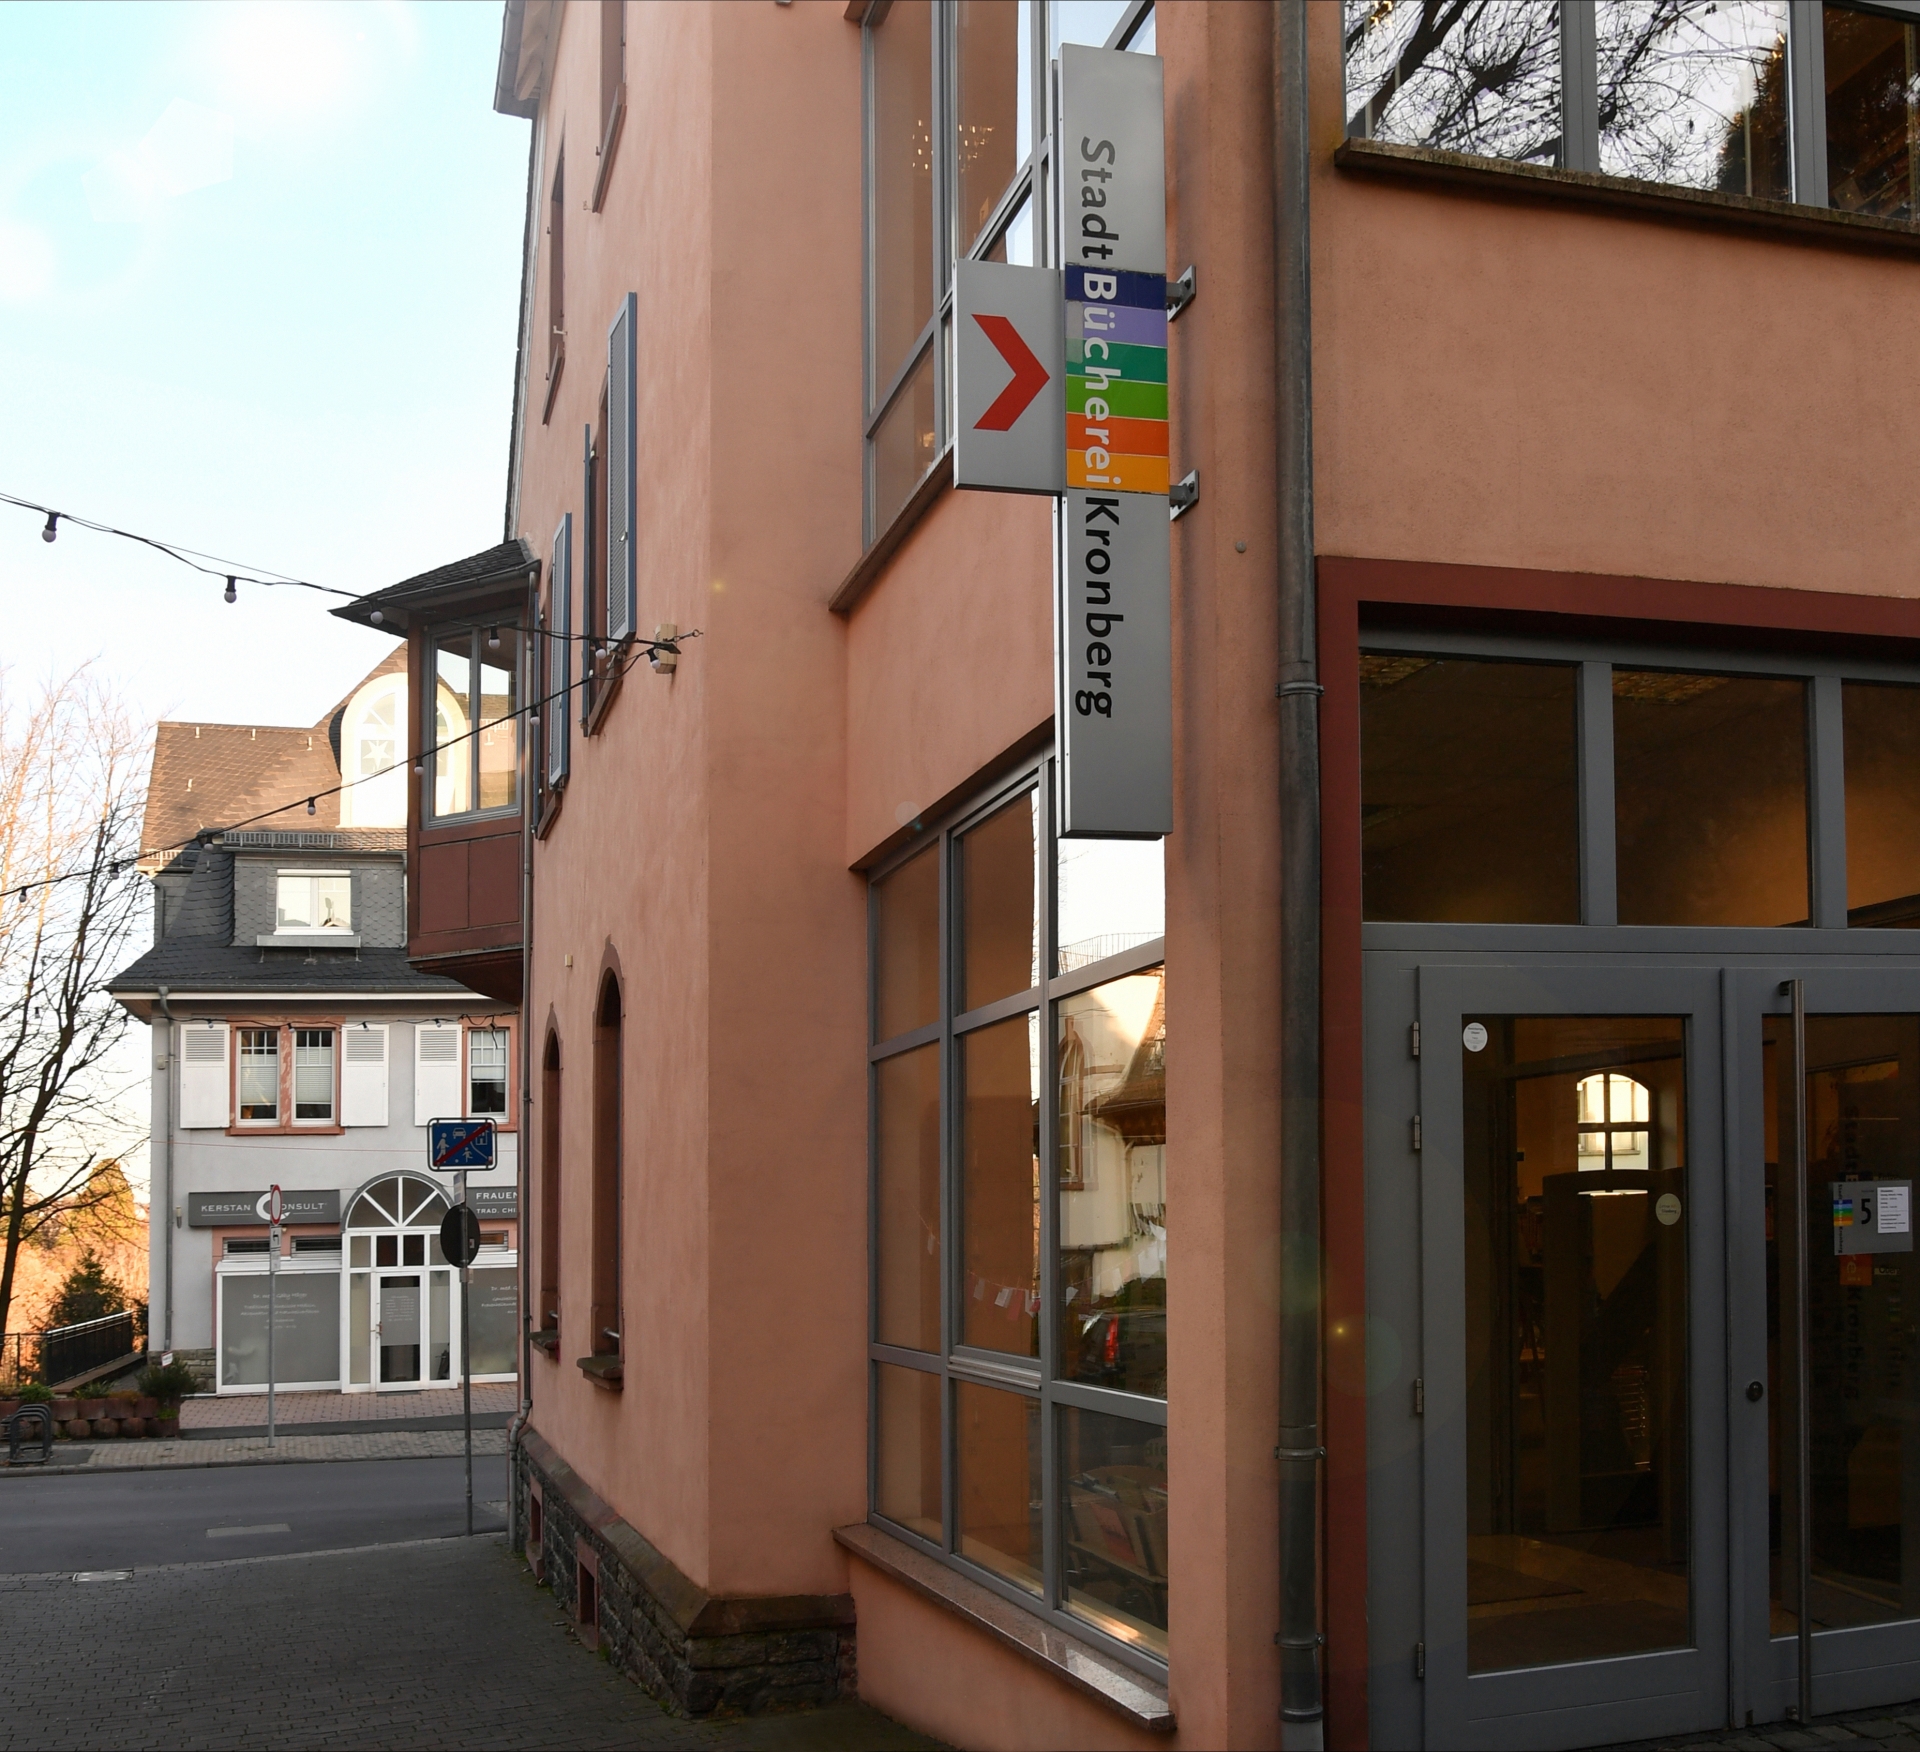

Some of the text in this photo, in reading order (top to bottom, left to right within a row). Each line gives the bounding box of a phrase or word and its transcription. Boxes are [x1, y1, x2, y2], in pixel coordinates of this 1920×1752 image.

[1074, 496, 1124, 718] Kronberg
[200, 1204, 251, 1212] KERSTAN
[1861, 1198, 1872, 1225] 5
